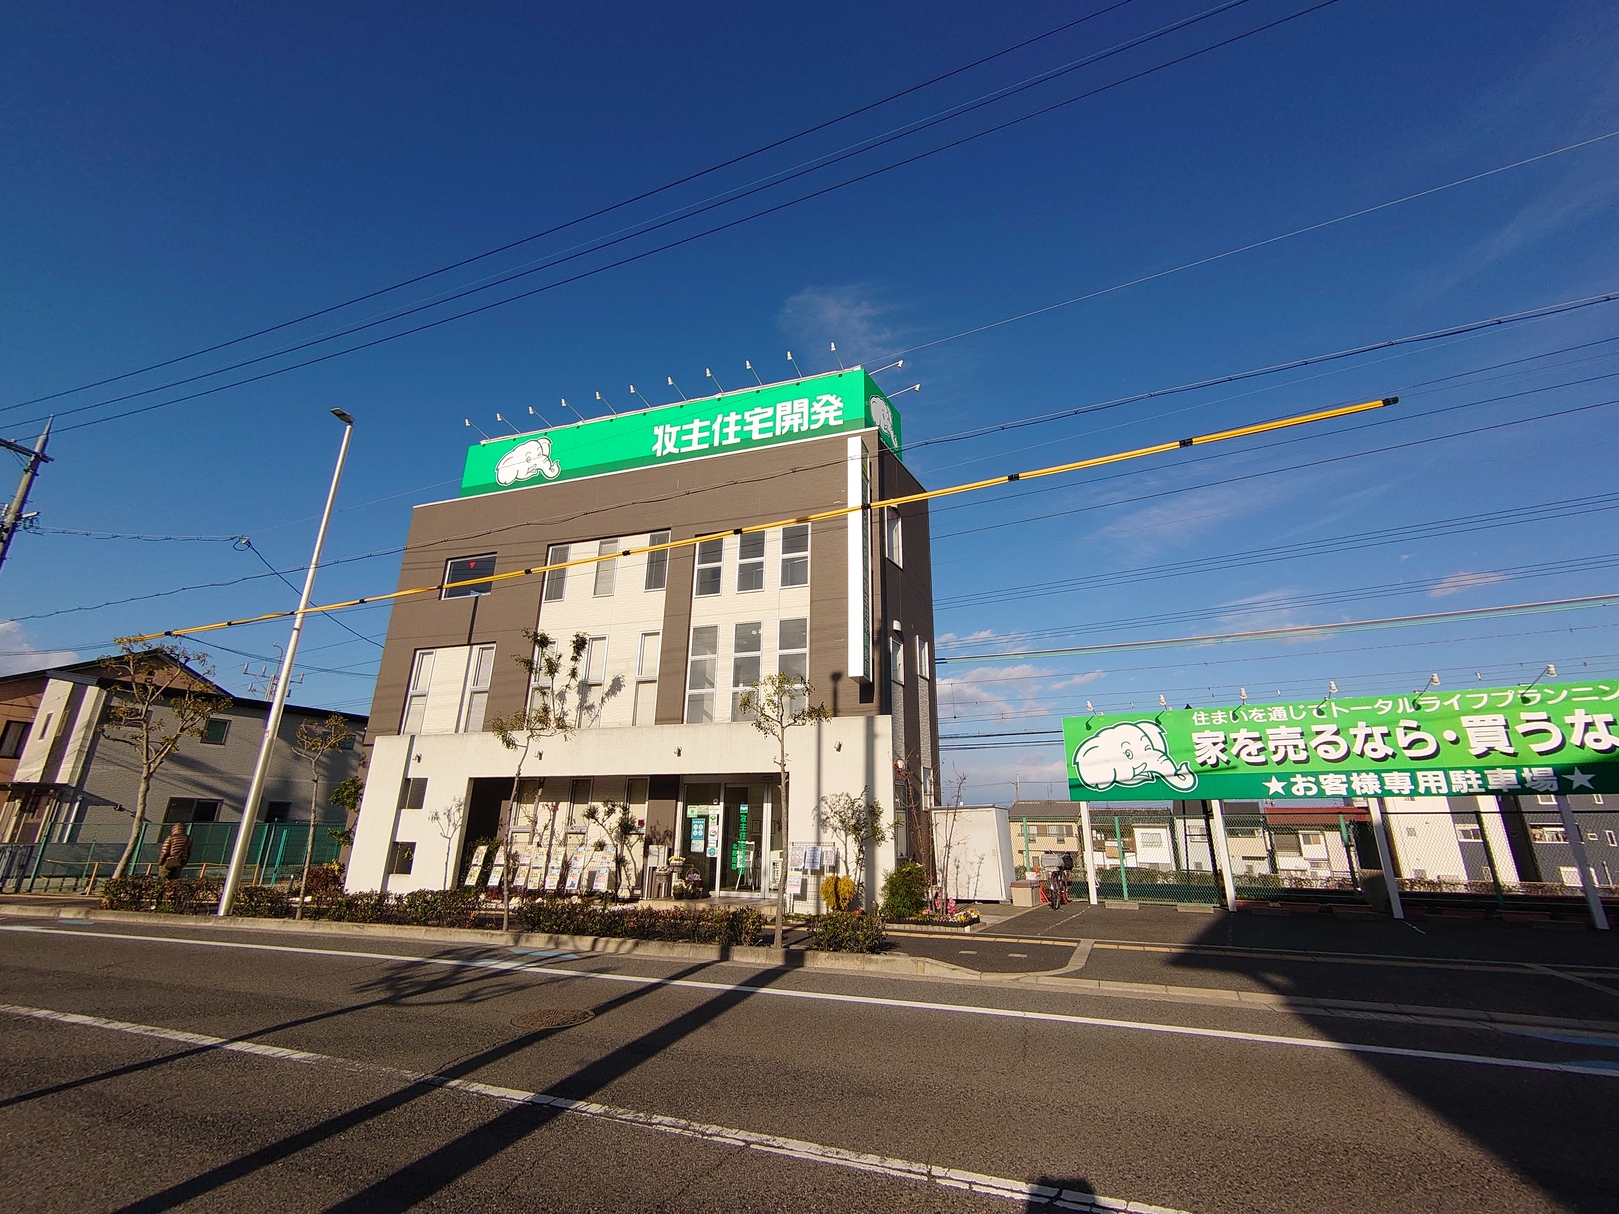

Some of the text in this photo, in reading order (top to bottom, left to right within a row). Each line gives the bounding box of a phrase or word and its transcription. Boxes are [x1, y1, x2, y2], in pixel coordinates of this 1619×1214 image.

[652, 394, 844, 457] 牧主住宅開発
[1192, 708, 1619, 766] 家を売るなら・買うな
[1289, 766, 1559, 796] お客様専用駐車場
